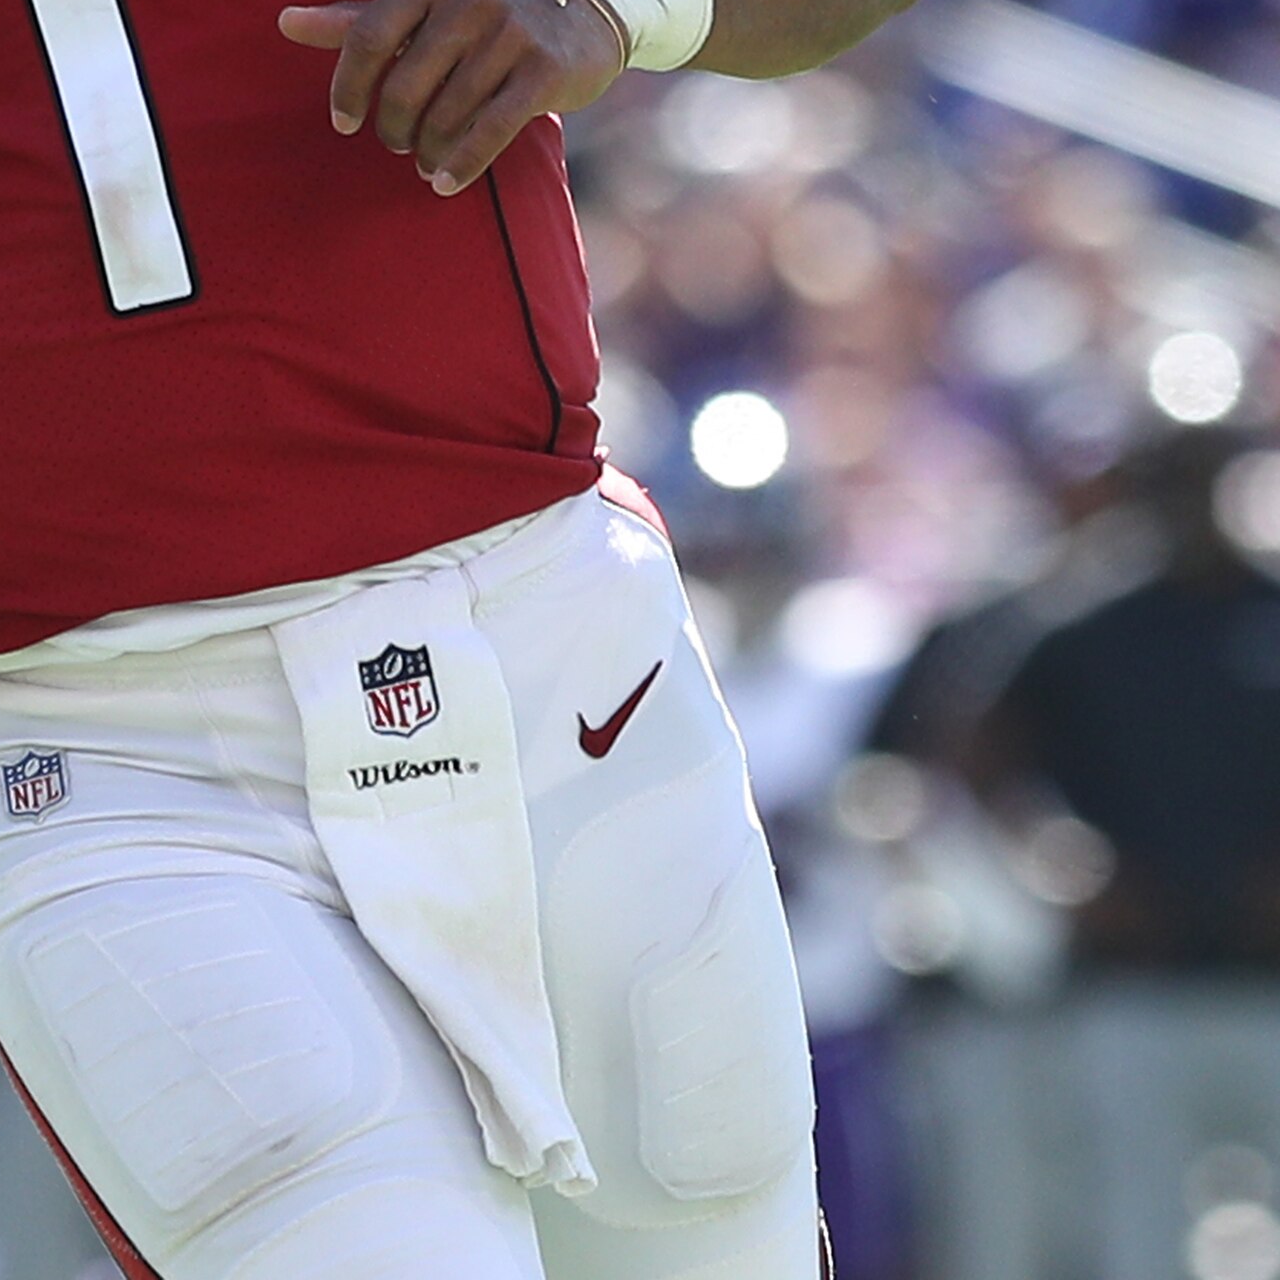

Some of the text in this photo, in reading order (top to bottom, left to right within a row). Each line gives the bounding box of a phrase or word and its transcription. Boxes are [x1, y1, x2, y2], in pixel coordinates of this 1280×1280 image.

[367, 680, 433, 729] NFL
[347, 757, 463, 791] Wilson
[11, 776, 60, 810] NFL
